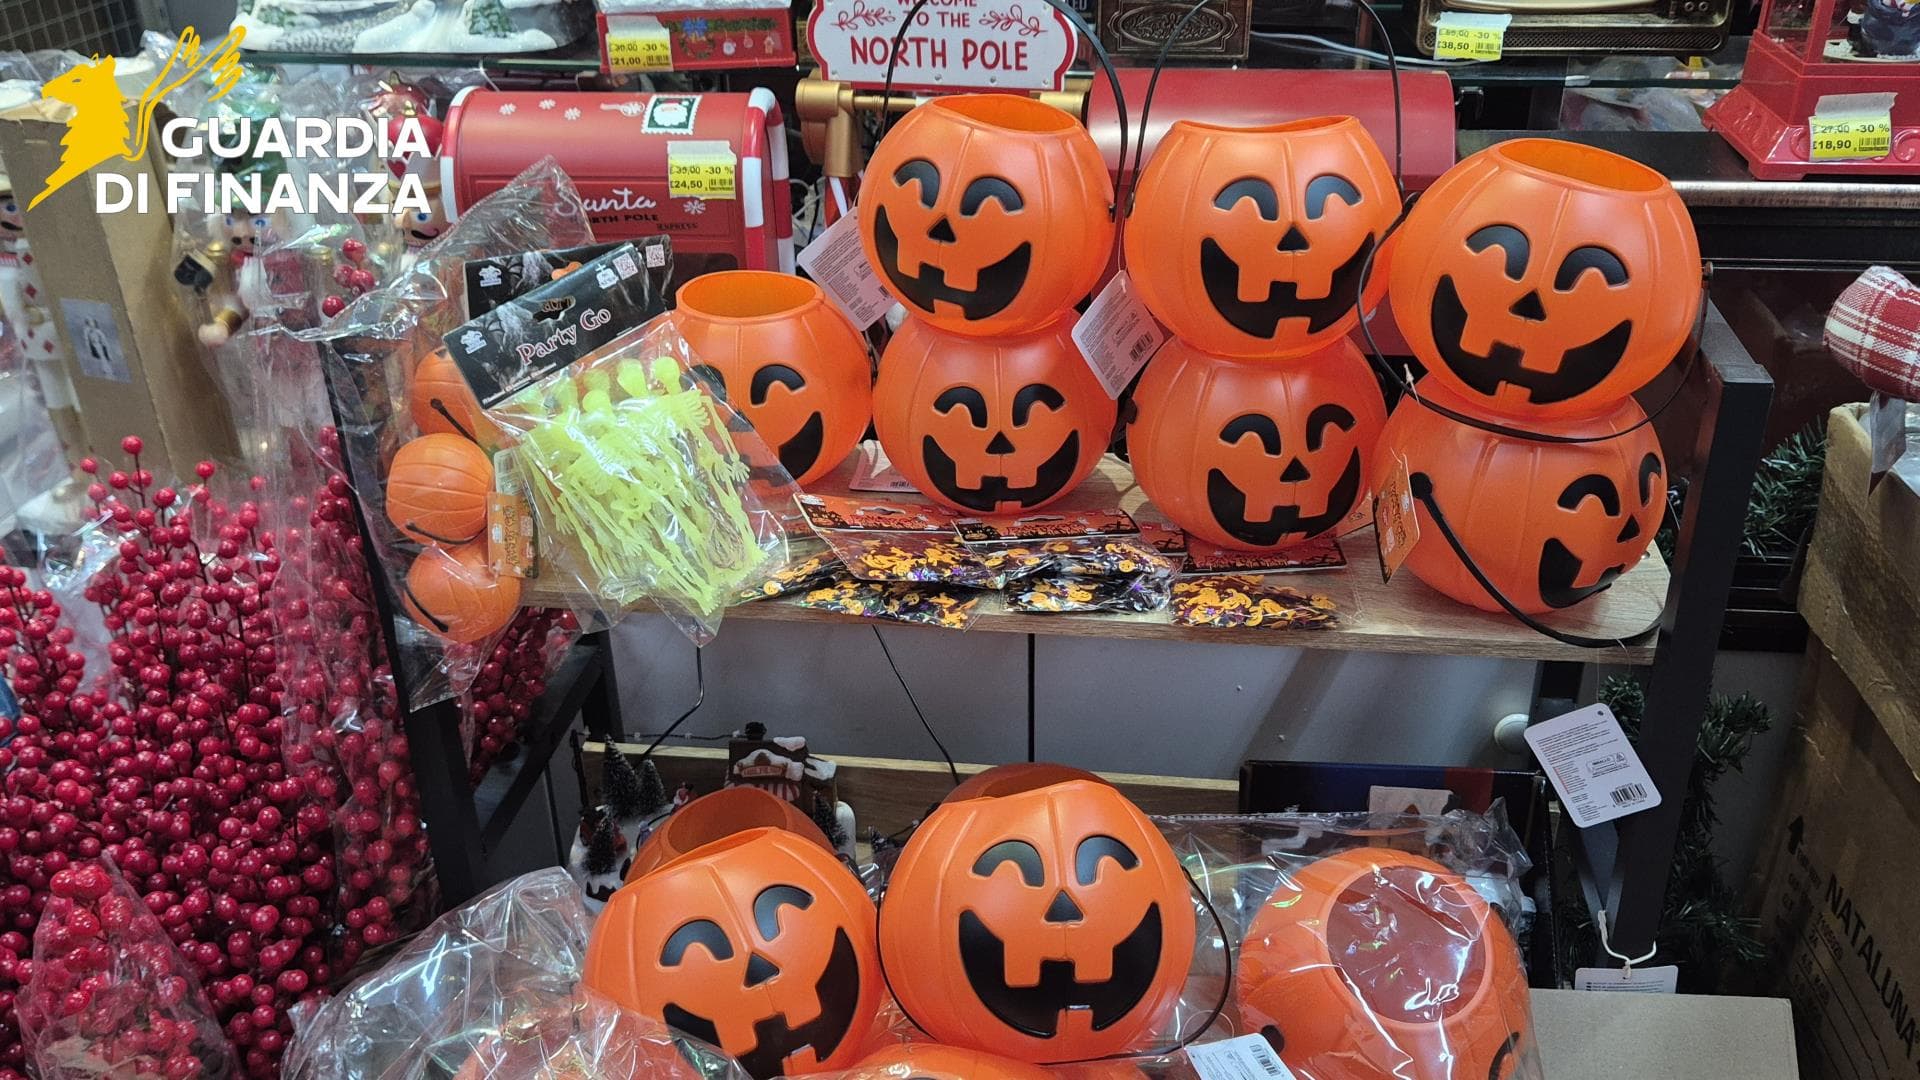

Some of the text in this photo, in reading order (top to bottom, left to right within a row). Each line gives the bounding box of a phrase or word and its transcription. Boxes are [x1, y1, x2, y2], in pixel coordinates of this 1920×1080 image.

[936, 11, 971, 28] THE
[850, 36, 1028, 71] NORTH POLE
[1856, 124, 1875, 133] -30
[705, 166, 721, 174] -30
[554, 187, 657, 217] Santa
[624, 214, 661, 223] POLE
[515, 323, 577, 366] Party
[579, 308, 612, 331] Go
[1825, 872, 1917, 1060] NATALUNA
